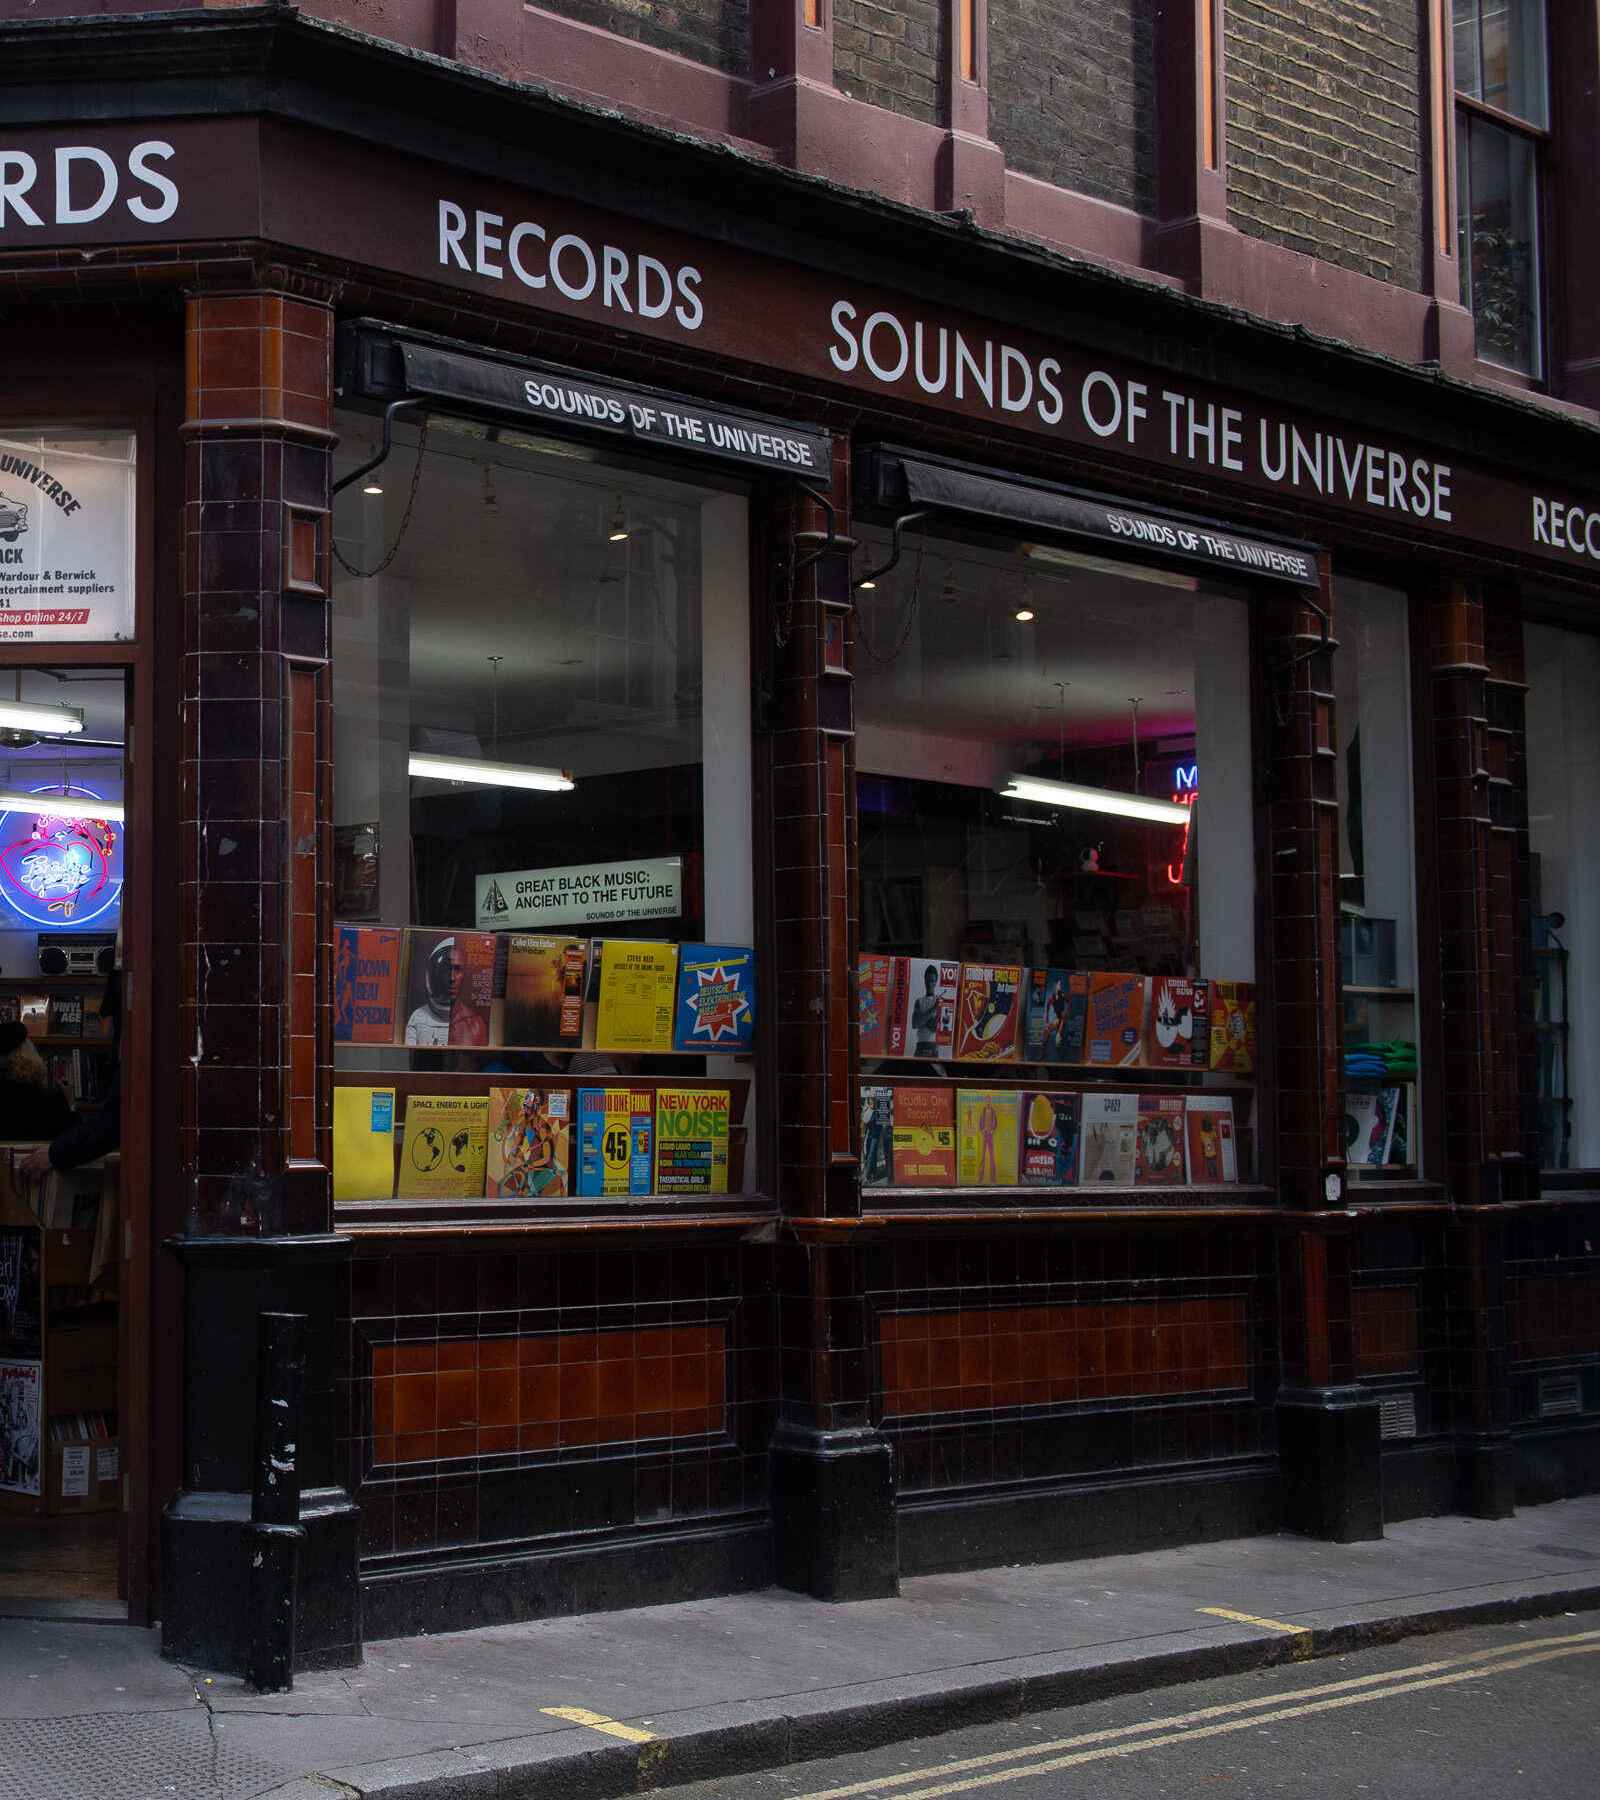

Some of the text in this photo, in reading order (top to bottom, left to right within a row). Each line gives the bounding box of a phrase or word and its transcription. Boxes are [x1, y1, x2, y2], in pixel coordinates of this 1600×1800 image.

[439, 200, 703, 330] RECORDS
[524, 380, 814, 467] SOUNDS OF THE UNIVERSE
[830, 300, 1452, 522] SOUNDS OF THE UNIVERSE
[0, 454, 82, 517] UNIVERSE
[1107, 513, 1308, 577] SOUNDS OF THE UNIVERSE
[43, 571, 52, 581] &
[55, 570, 96, 581] Berwick
[67, 583, 115, 596] suppliers
[24, 612, 55, 623] Online
[58, 611, 84, 624] 24/7
[515, 871, 650, 895] GREAT BLACK MUSIC:
[515, 884, 674, 910] ANCIENT TO THE FUTURE
[586, 905, 678, 921] SOUNDS OF THE UNIVERSE
[412, 1100, 434, 1109] SPACE,
[436, 1100, 462, 1109] ENERGY
[463, 1101, 469, 1109] &
[659, 1095, 728, 1110] NEW YORK
[659, 1110, 728, 1137] NOISE
[606, 1132, 627, 1161] 45
